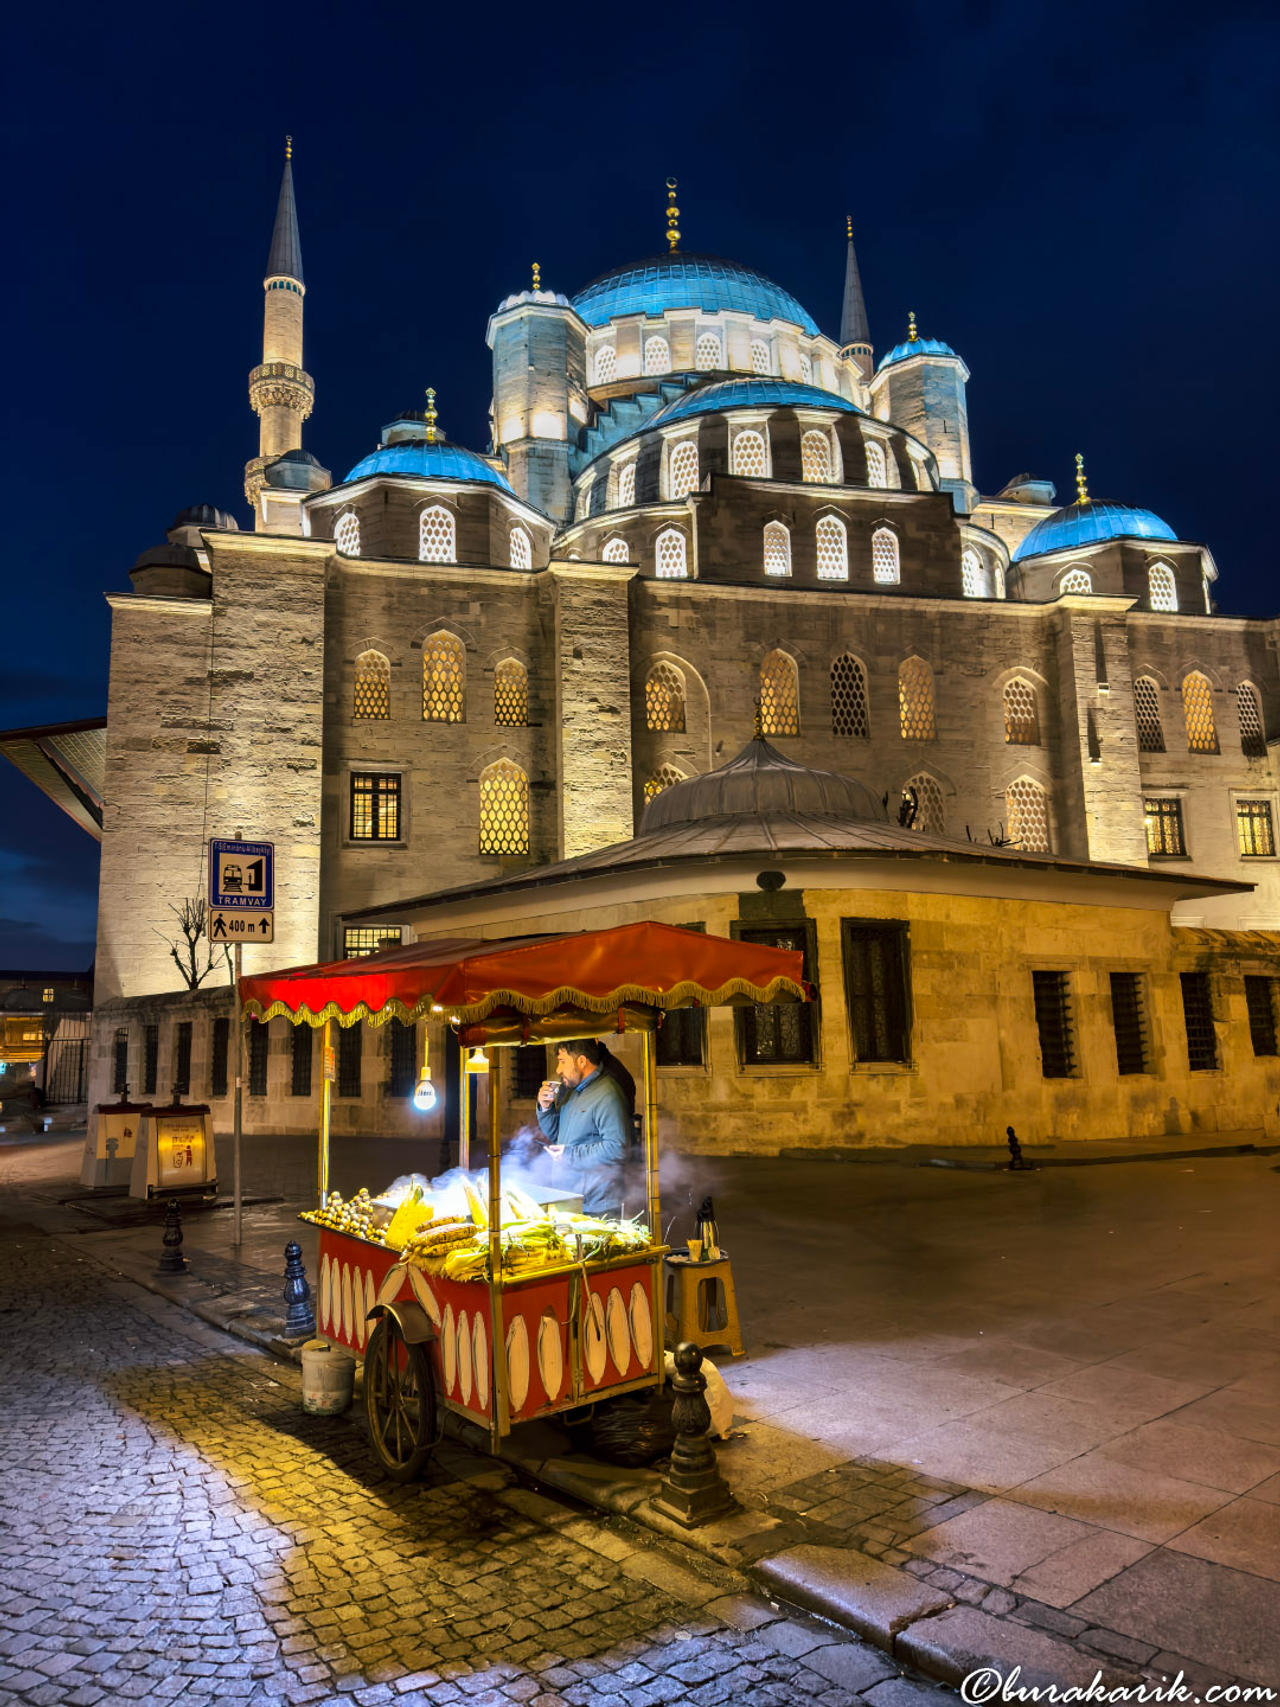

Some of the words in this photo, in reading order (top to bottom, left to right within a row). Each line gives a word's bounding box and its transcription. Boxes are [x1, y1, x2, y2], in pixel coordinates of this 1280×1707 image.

[218, 896, 267, 906] TRAMVAY
[229, 920, 245, 932] 400
[247, 923, 255, 932] m
